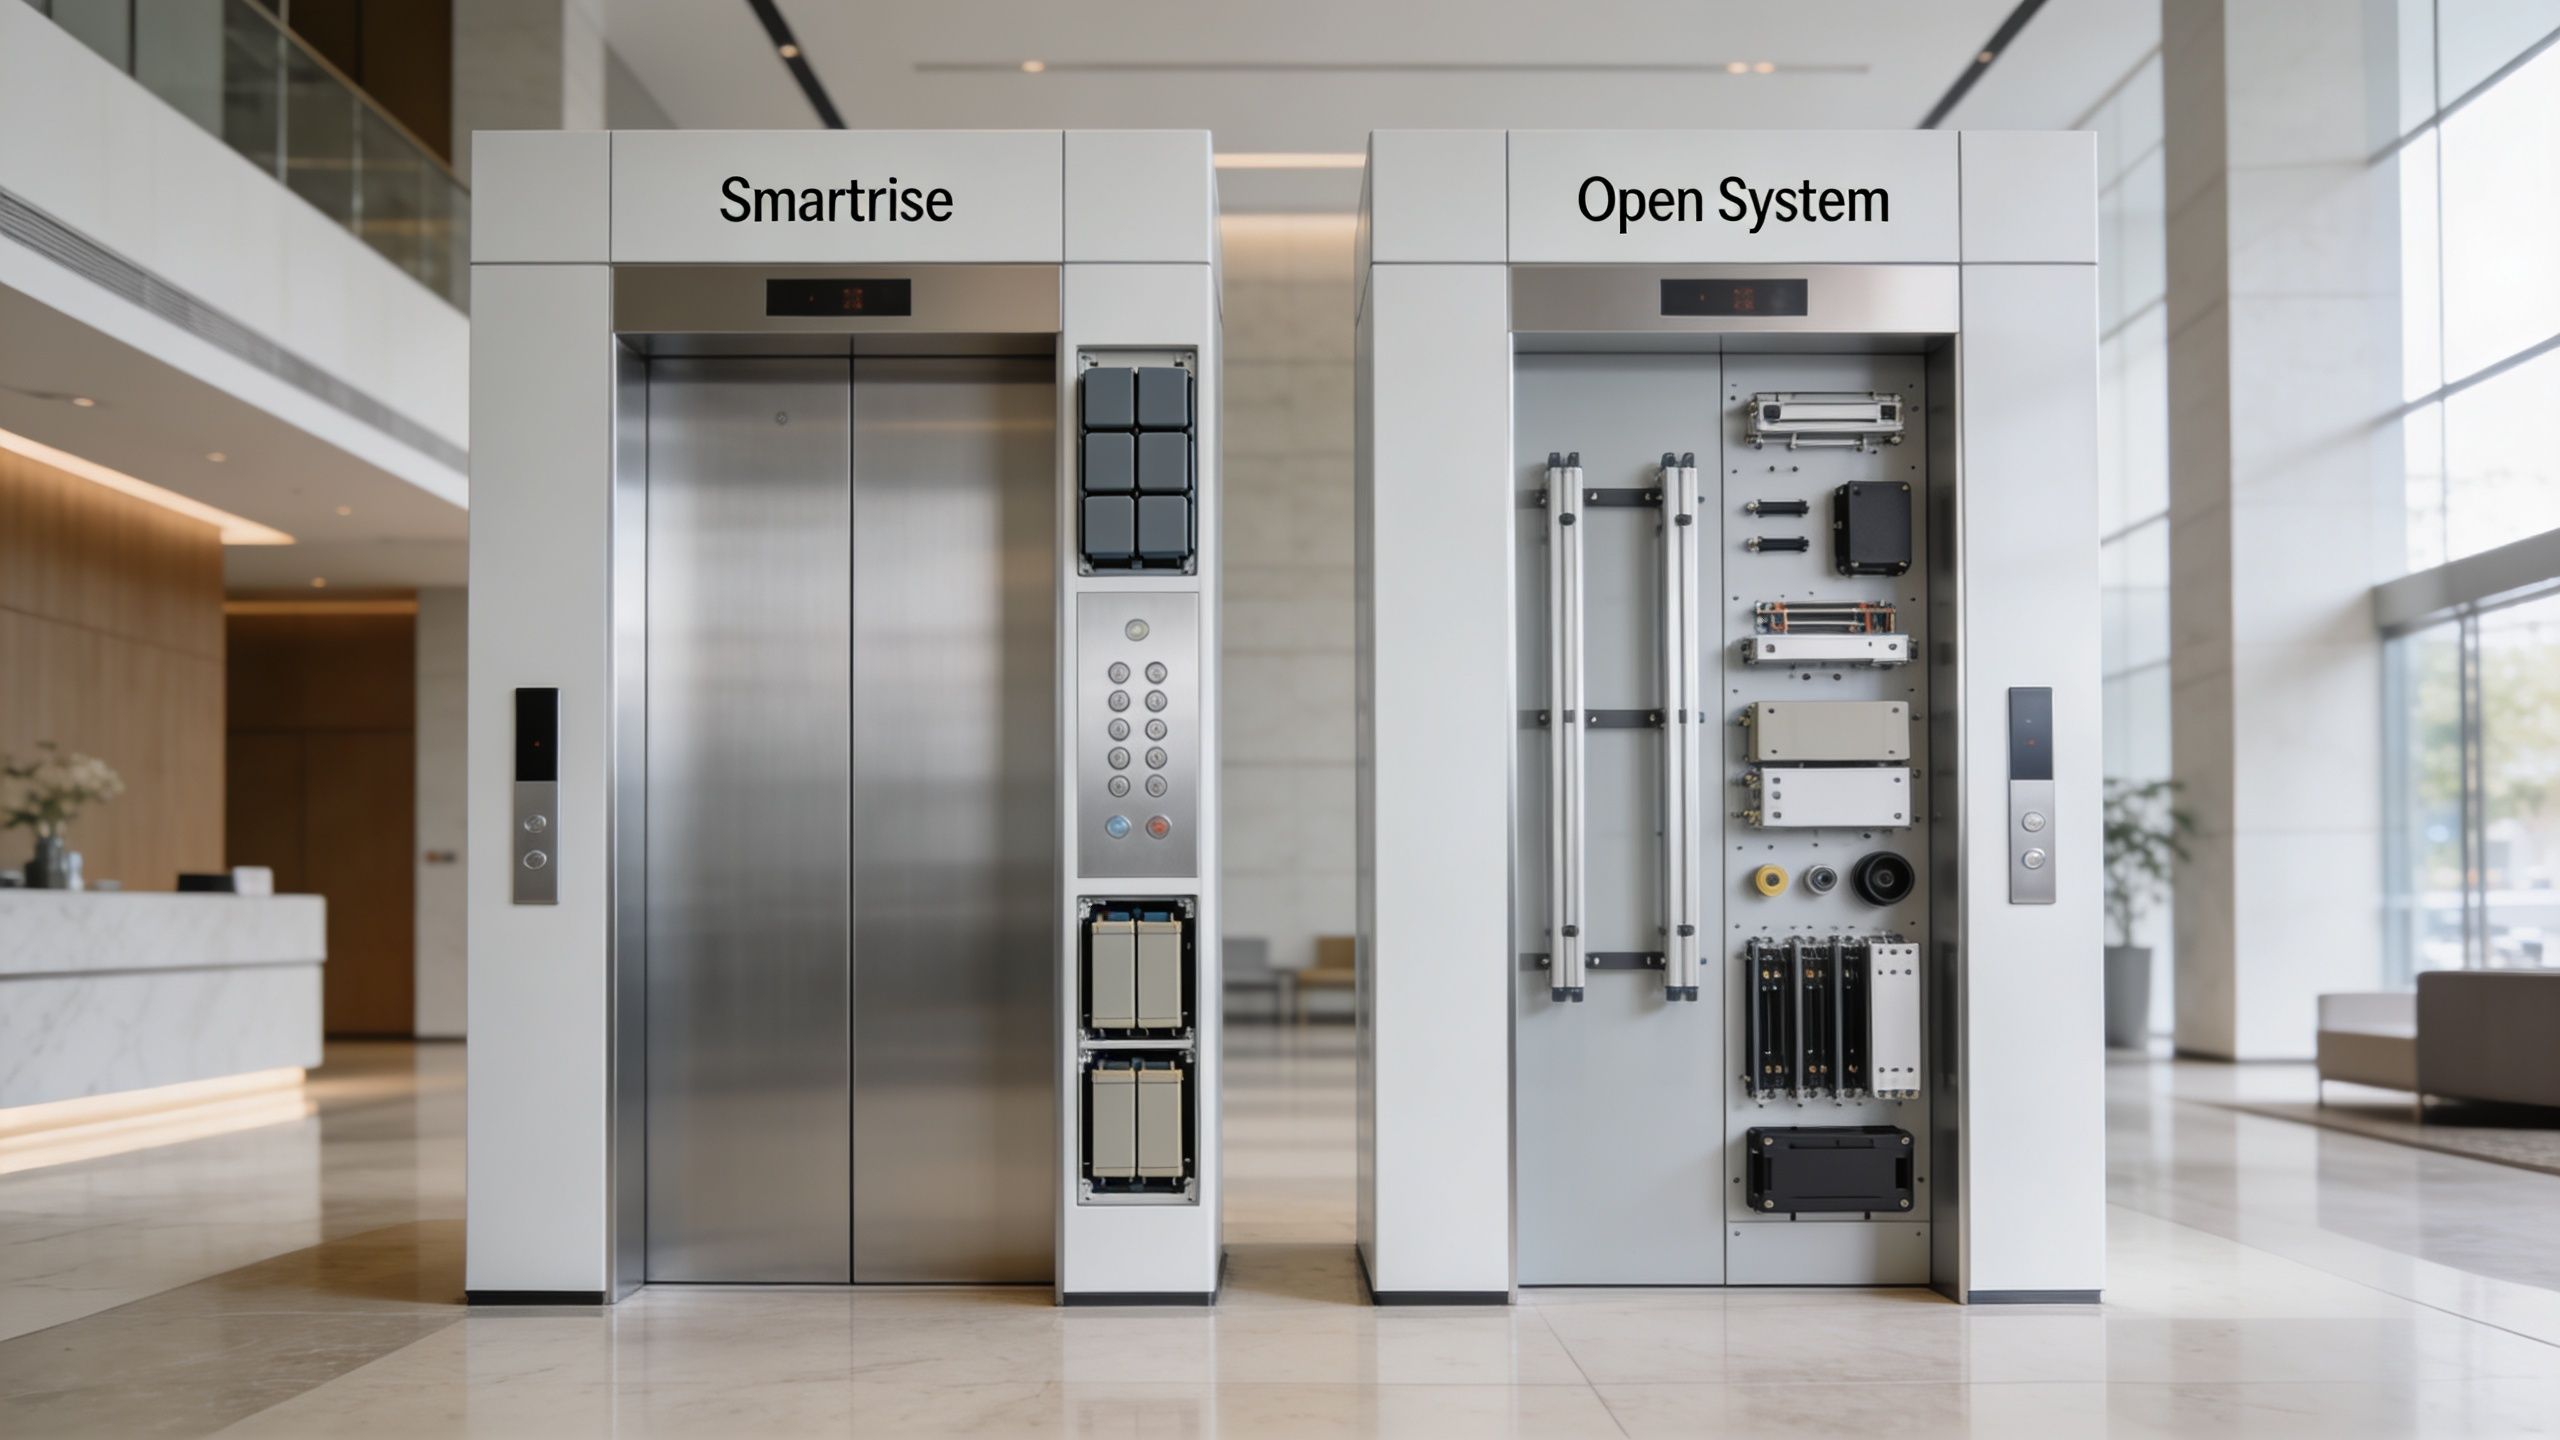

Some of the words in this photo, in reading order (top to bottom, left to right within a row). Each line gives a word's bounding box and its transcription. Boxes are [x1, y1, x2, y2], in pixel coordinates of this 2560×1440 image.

[719, 175, 954, 223] Smartrise
[1578, 175, 1703, 235] Open
[1718, 175, 1889, 234] System
